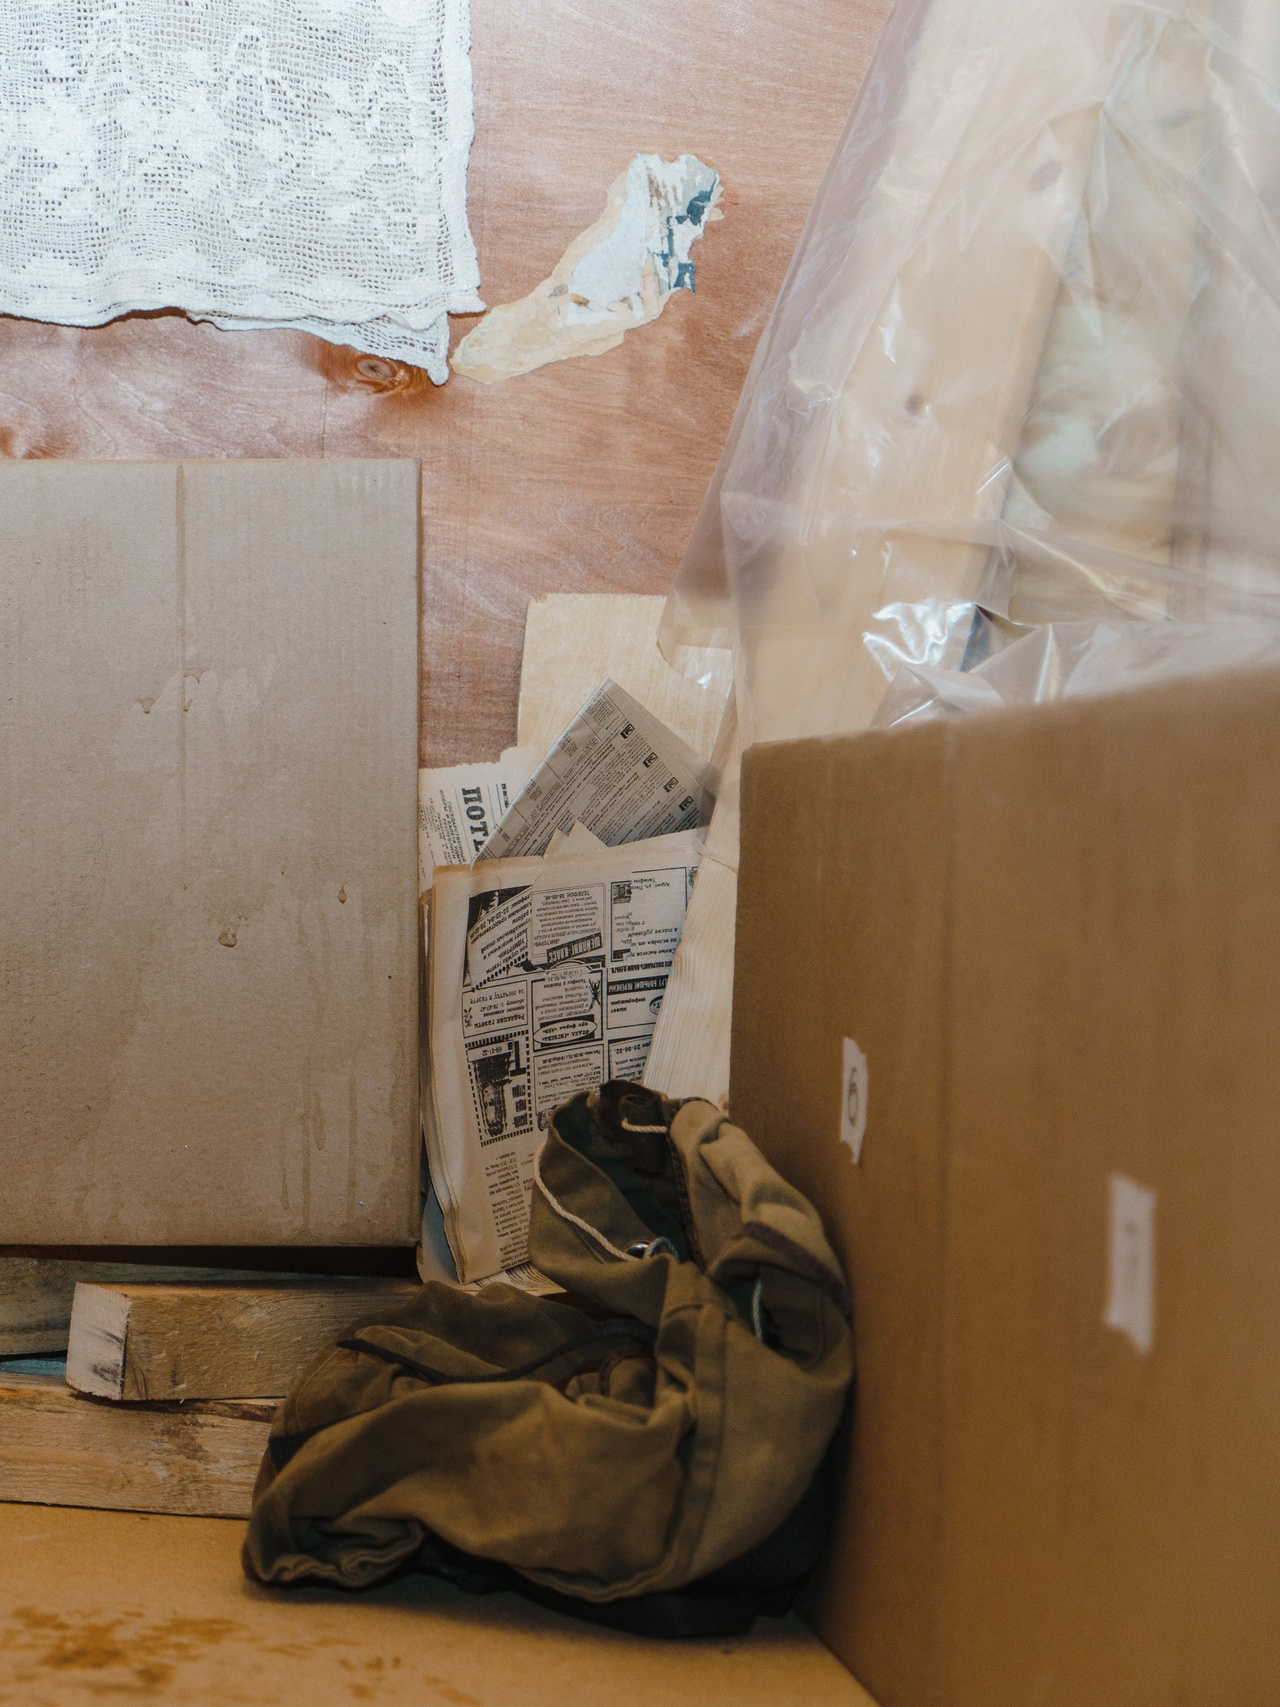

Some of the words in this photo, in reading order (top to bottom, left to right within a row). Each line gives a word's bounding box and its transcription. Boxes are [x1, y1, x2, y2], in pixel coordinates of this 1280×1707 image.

[454, 846, 462, 864] УДМУ
[611, 997, 645, 1006] информацию
[474, 1019, 495, 1029] газеты
[496, 1013, 525, 1025] Редакция
[848, 1065, 859, 1128] 6
